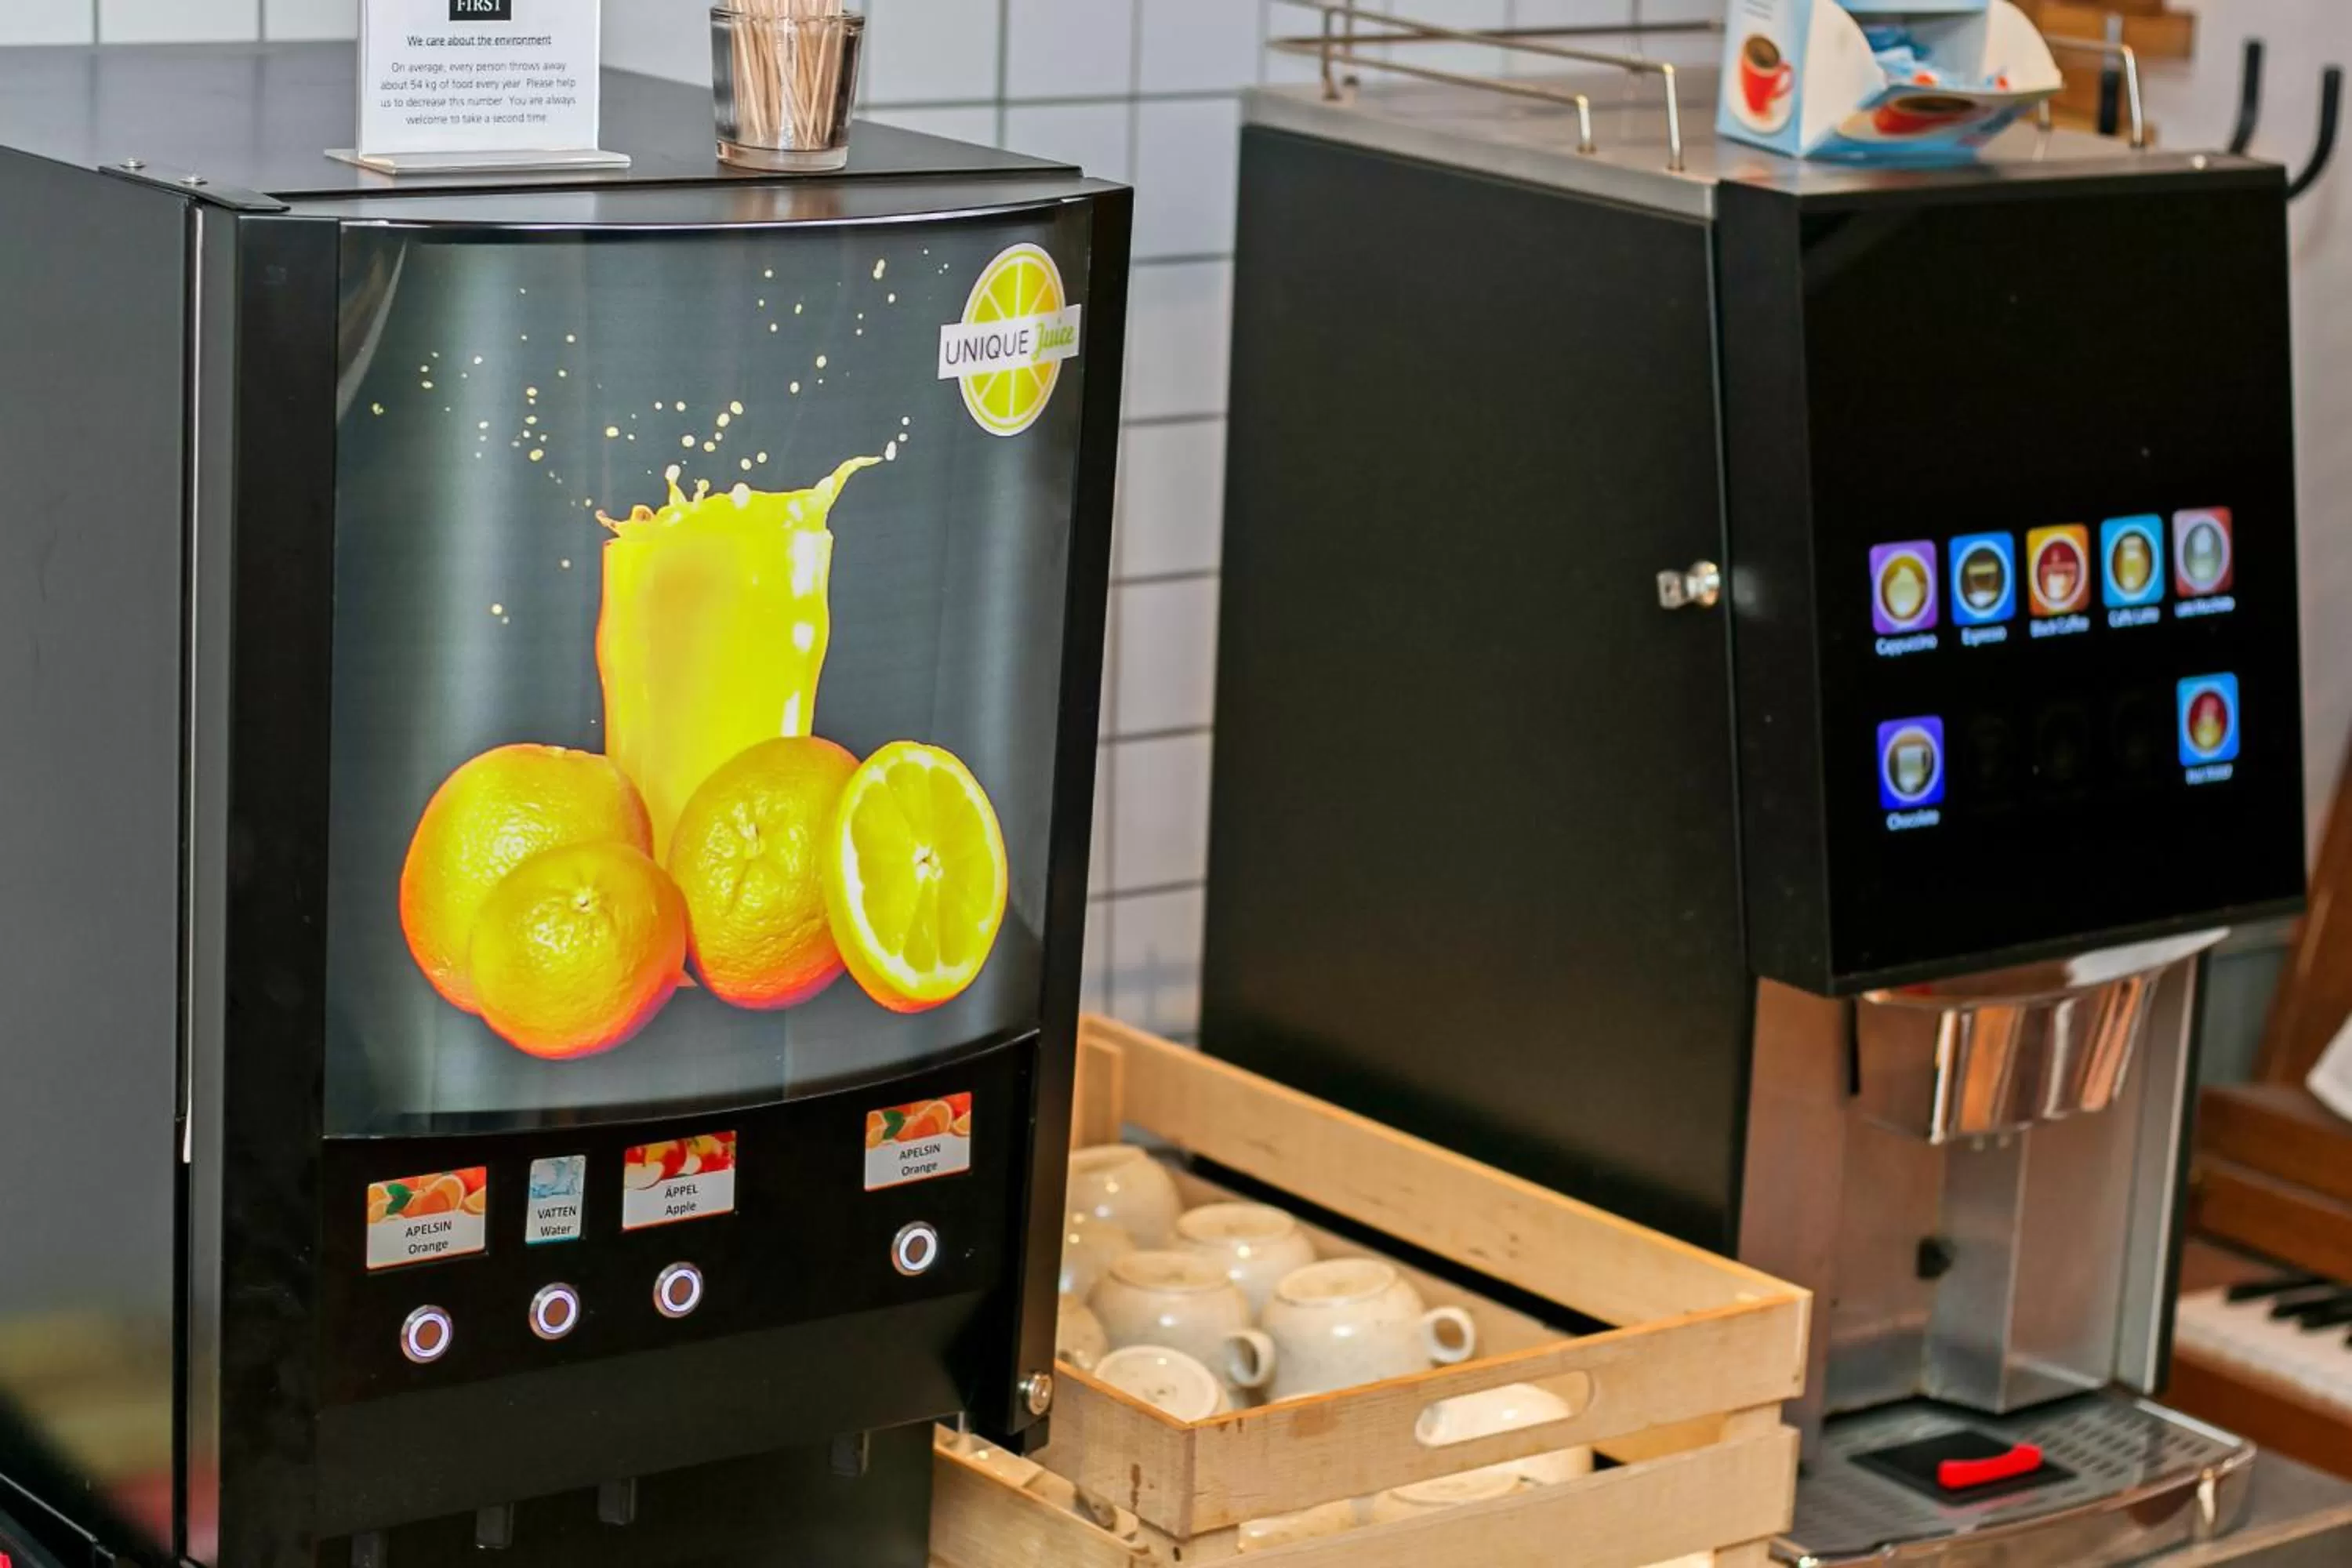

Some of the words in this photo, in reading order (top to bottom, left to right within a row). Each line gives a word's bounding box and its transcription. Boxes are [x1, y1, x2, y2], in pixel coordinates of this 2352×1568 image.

[407, 35, 423, 46] We
[426, 36, 445, 46] care
[447, 34, 474, 46] about
[477, 34, 492, 46] the
[494, 34, 552, 46] environment
[391, 62, 405, 73] On
[449, 63, 474, 74] every
[476, 63, 506, 74] person
[508, 61, 540, 71] throws
[543, 62, 566, 73] away
[380, 79, 408, 90] about
[410, 79, 423, 90] 54
[425, 79, 437, 91] kg
[438, 78, 449, 89] of
[452, 78, 473, 89] food
[476, 80, 499, 91] every
[526, 78, 554, 89] Please
[556, 78, 576, 90] help
[380, 99, 392, 107] us
[394, 98, 404, 107] to
[405, 96, 446, 107] decrease
[448, 96, 465, 107] this
[509, 95, 527, 107] You
[529, 96, 543, 106] are
[545, 94, 576, 107] always
[405, 114, 448, 125] welcome
[449, 114, 460, 124] to
[462, 113, 482, 124] take
[492, 113, 524, 123] second
[946, 329, 1029, 365] UNIQUE
[1030, 317, 1075, 361] Juice
[899, 1143, 942, 1160] APELSIN
[901, 1161, 938, 1177] Orange
[664, 1183, 699, 1199] ÄPPEL
[537, 1205, 578, 1219] VATTEN
[664, 1200, 697, 1216] Apple
[405, 1220, 452, 1238] APELSIN
[540, 1225, 573, 1236] Water
[408, 1240, 449, 1254] Orange
